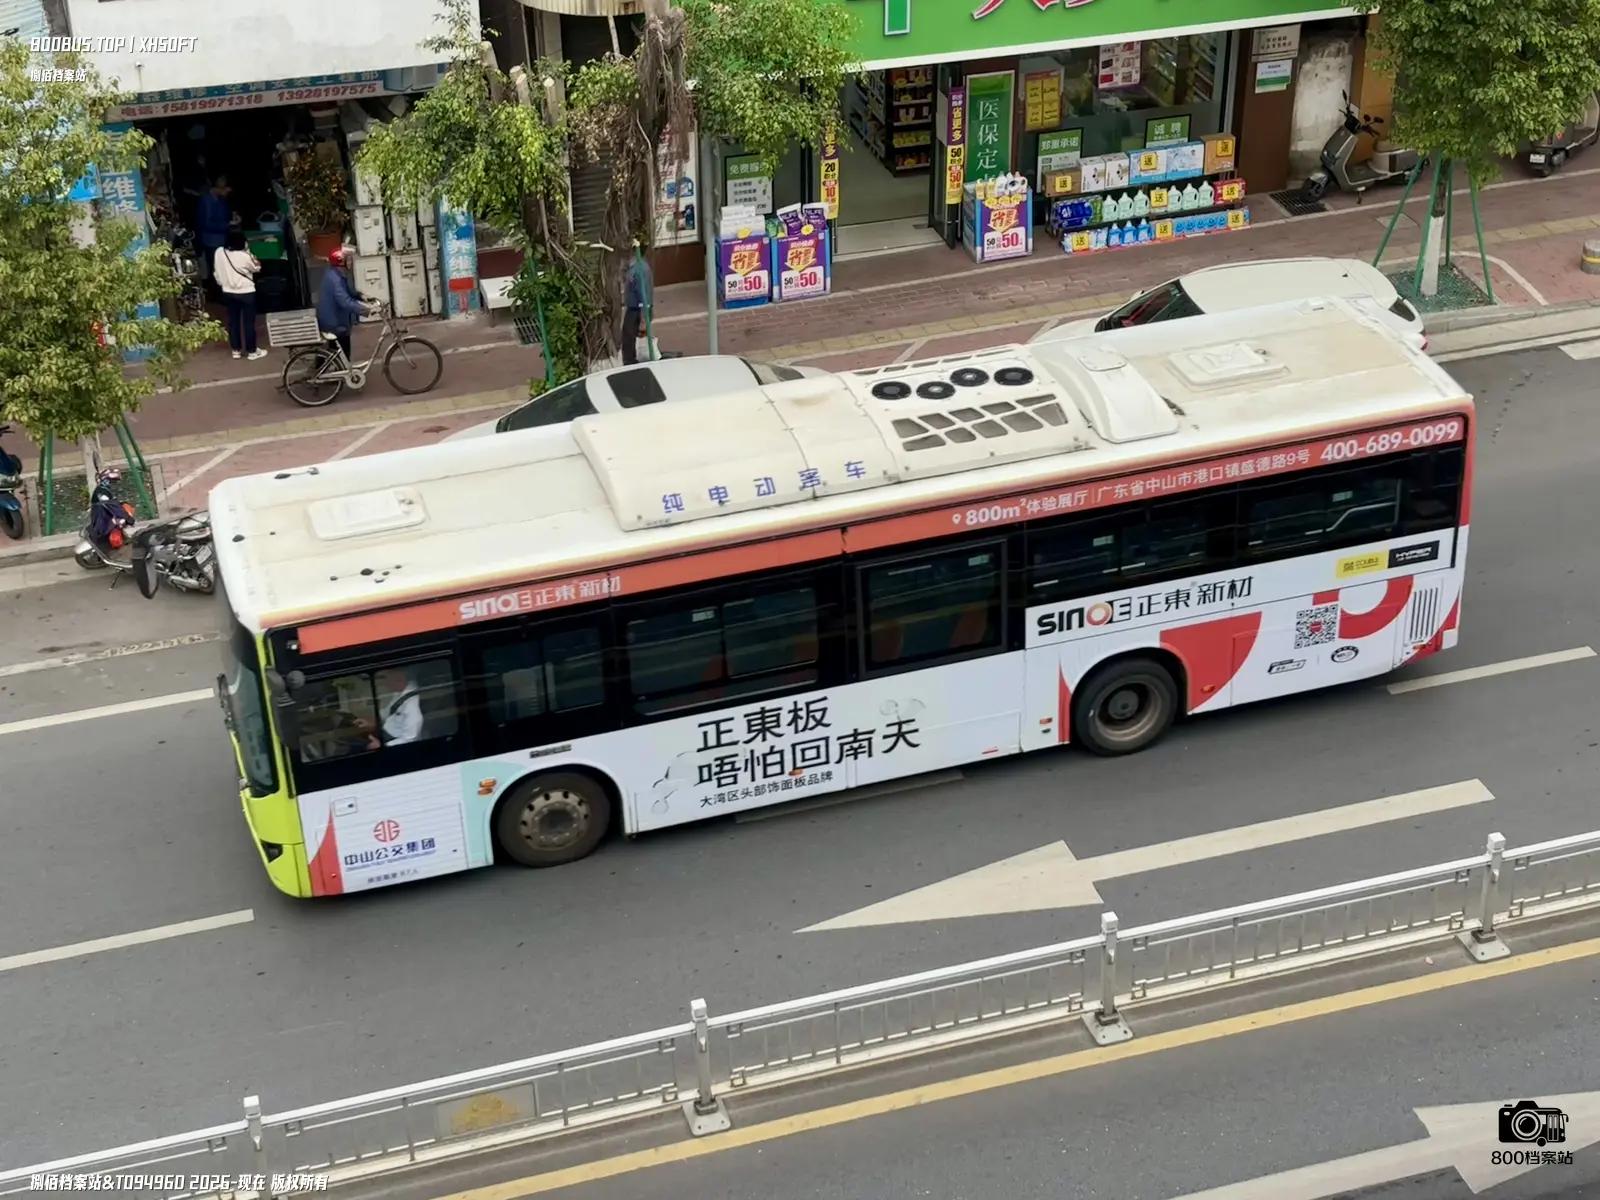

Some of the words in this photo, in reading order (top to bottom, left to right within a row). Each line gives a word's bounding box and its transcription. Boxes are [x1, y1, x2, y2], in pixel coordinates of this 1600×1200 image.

[976, 98, 1000, 182] 医保定
[950, 147, 962, 158] 50
[824, 162, 836, 173] 20
[949, 171, 961, 183] 50
[825, 187, 836, 198] 10
[986, 237, 996, 246] 50
[1002, 232, 1020, 248] 50
[727, 280, 738, 289] 50
[744, 275, 762, 291] 50
[784, 276, 794, 286] 50
[800, 271, 818, 288] 50
[1320, 421, 1460, 463] 400-689-0099
[696, 696, 832, 753] 正東板
[693, 718, 921, 789] 唔怕回南天
[700, 770, 833, 808] 大湾区头部饰面板品牌
[344, 837, 436, 867] 中山公交集团
